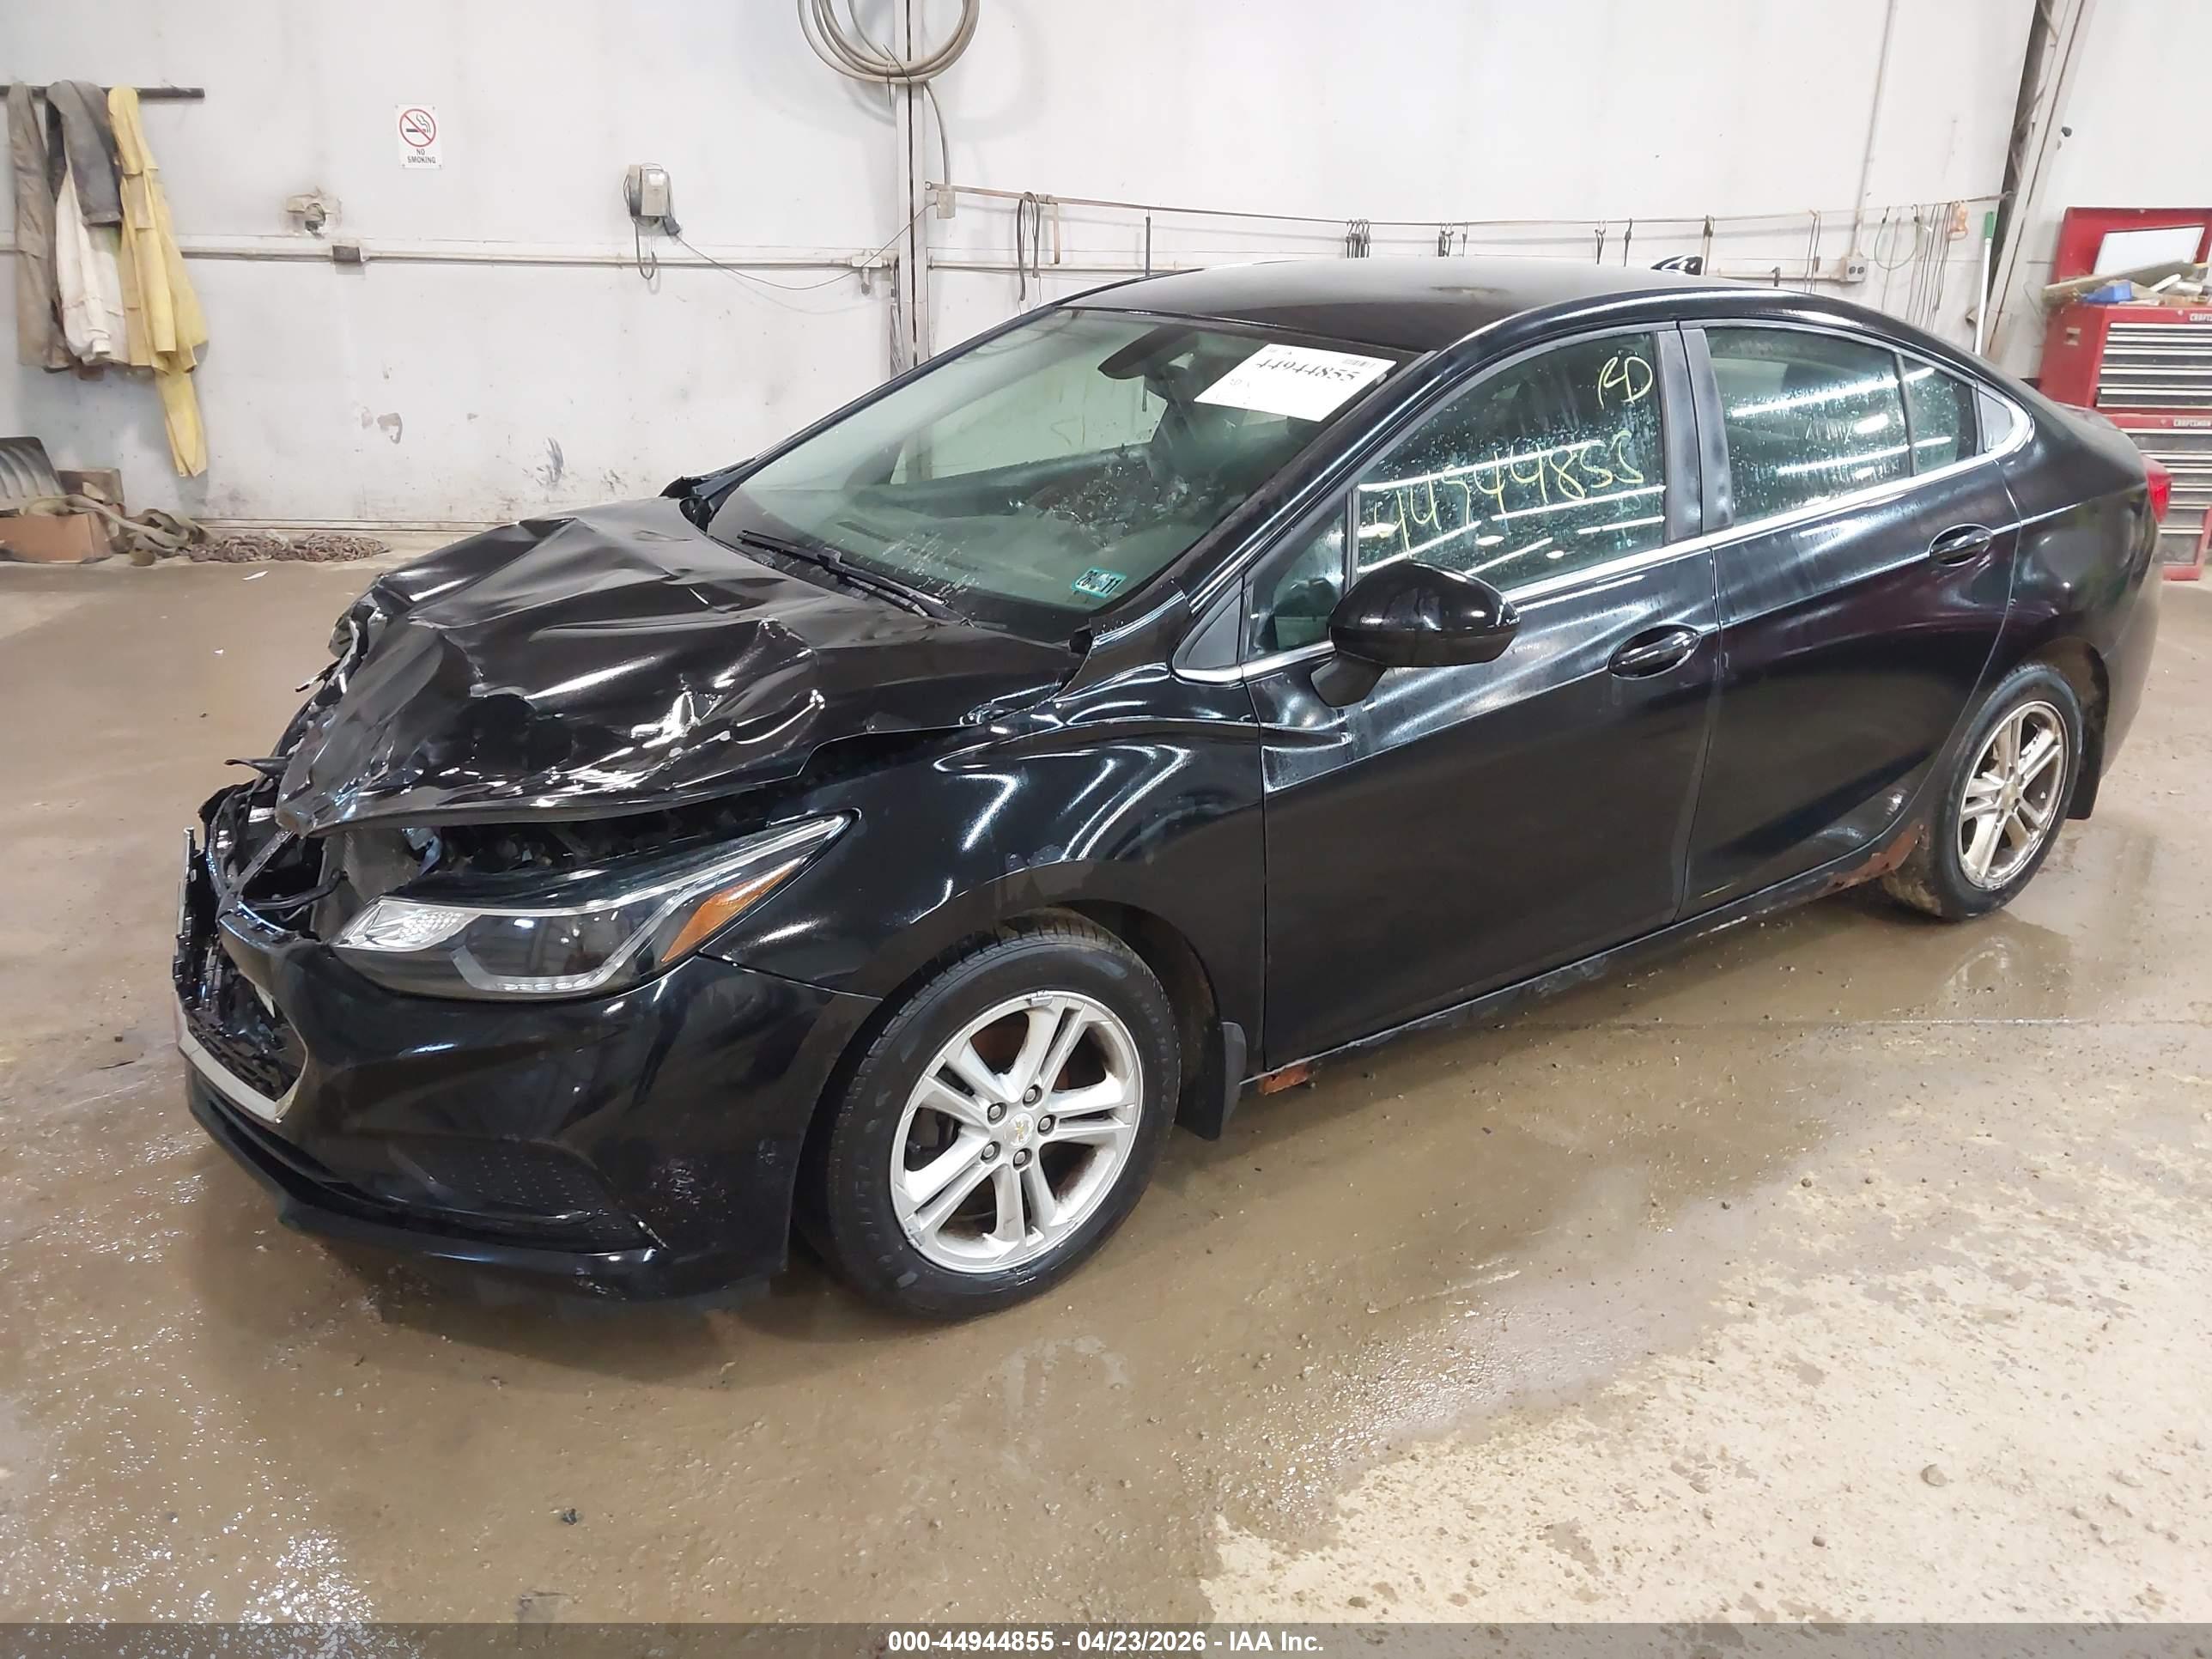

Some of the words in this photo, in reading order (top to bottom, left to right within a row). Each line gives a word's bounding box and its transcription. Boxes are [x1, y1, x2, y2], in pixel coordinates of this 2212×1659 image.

[416, 148, 426, 156] NO
[407, 155, 437, 164] SMOKING
[1256, 358, 1361, 382] 44944855
